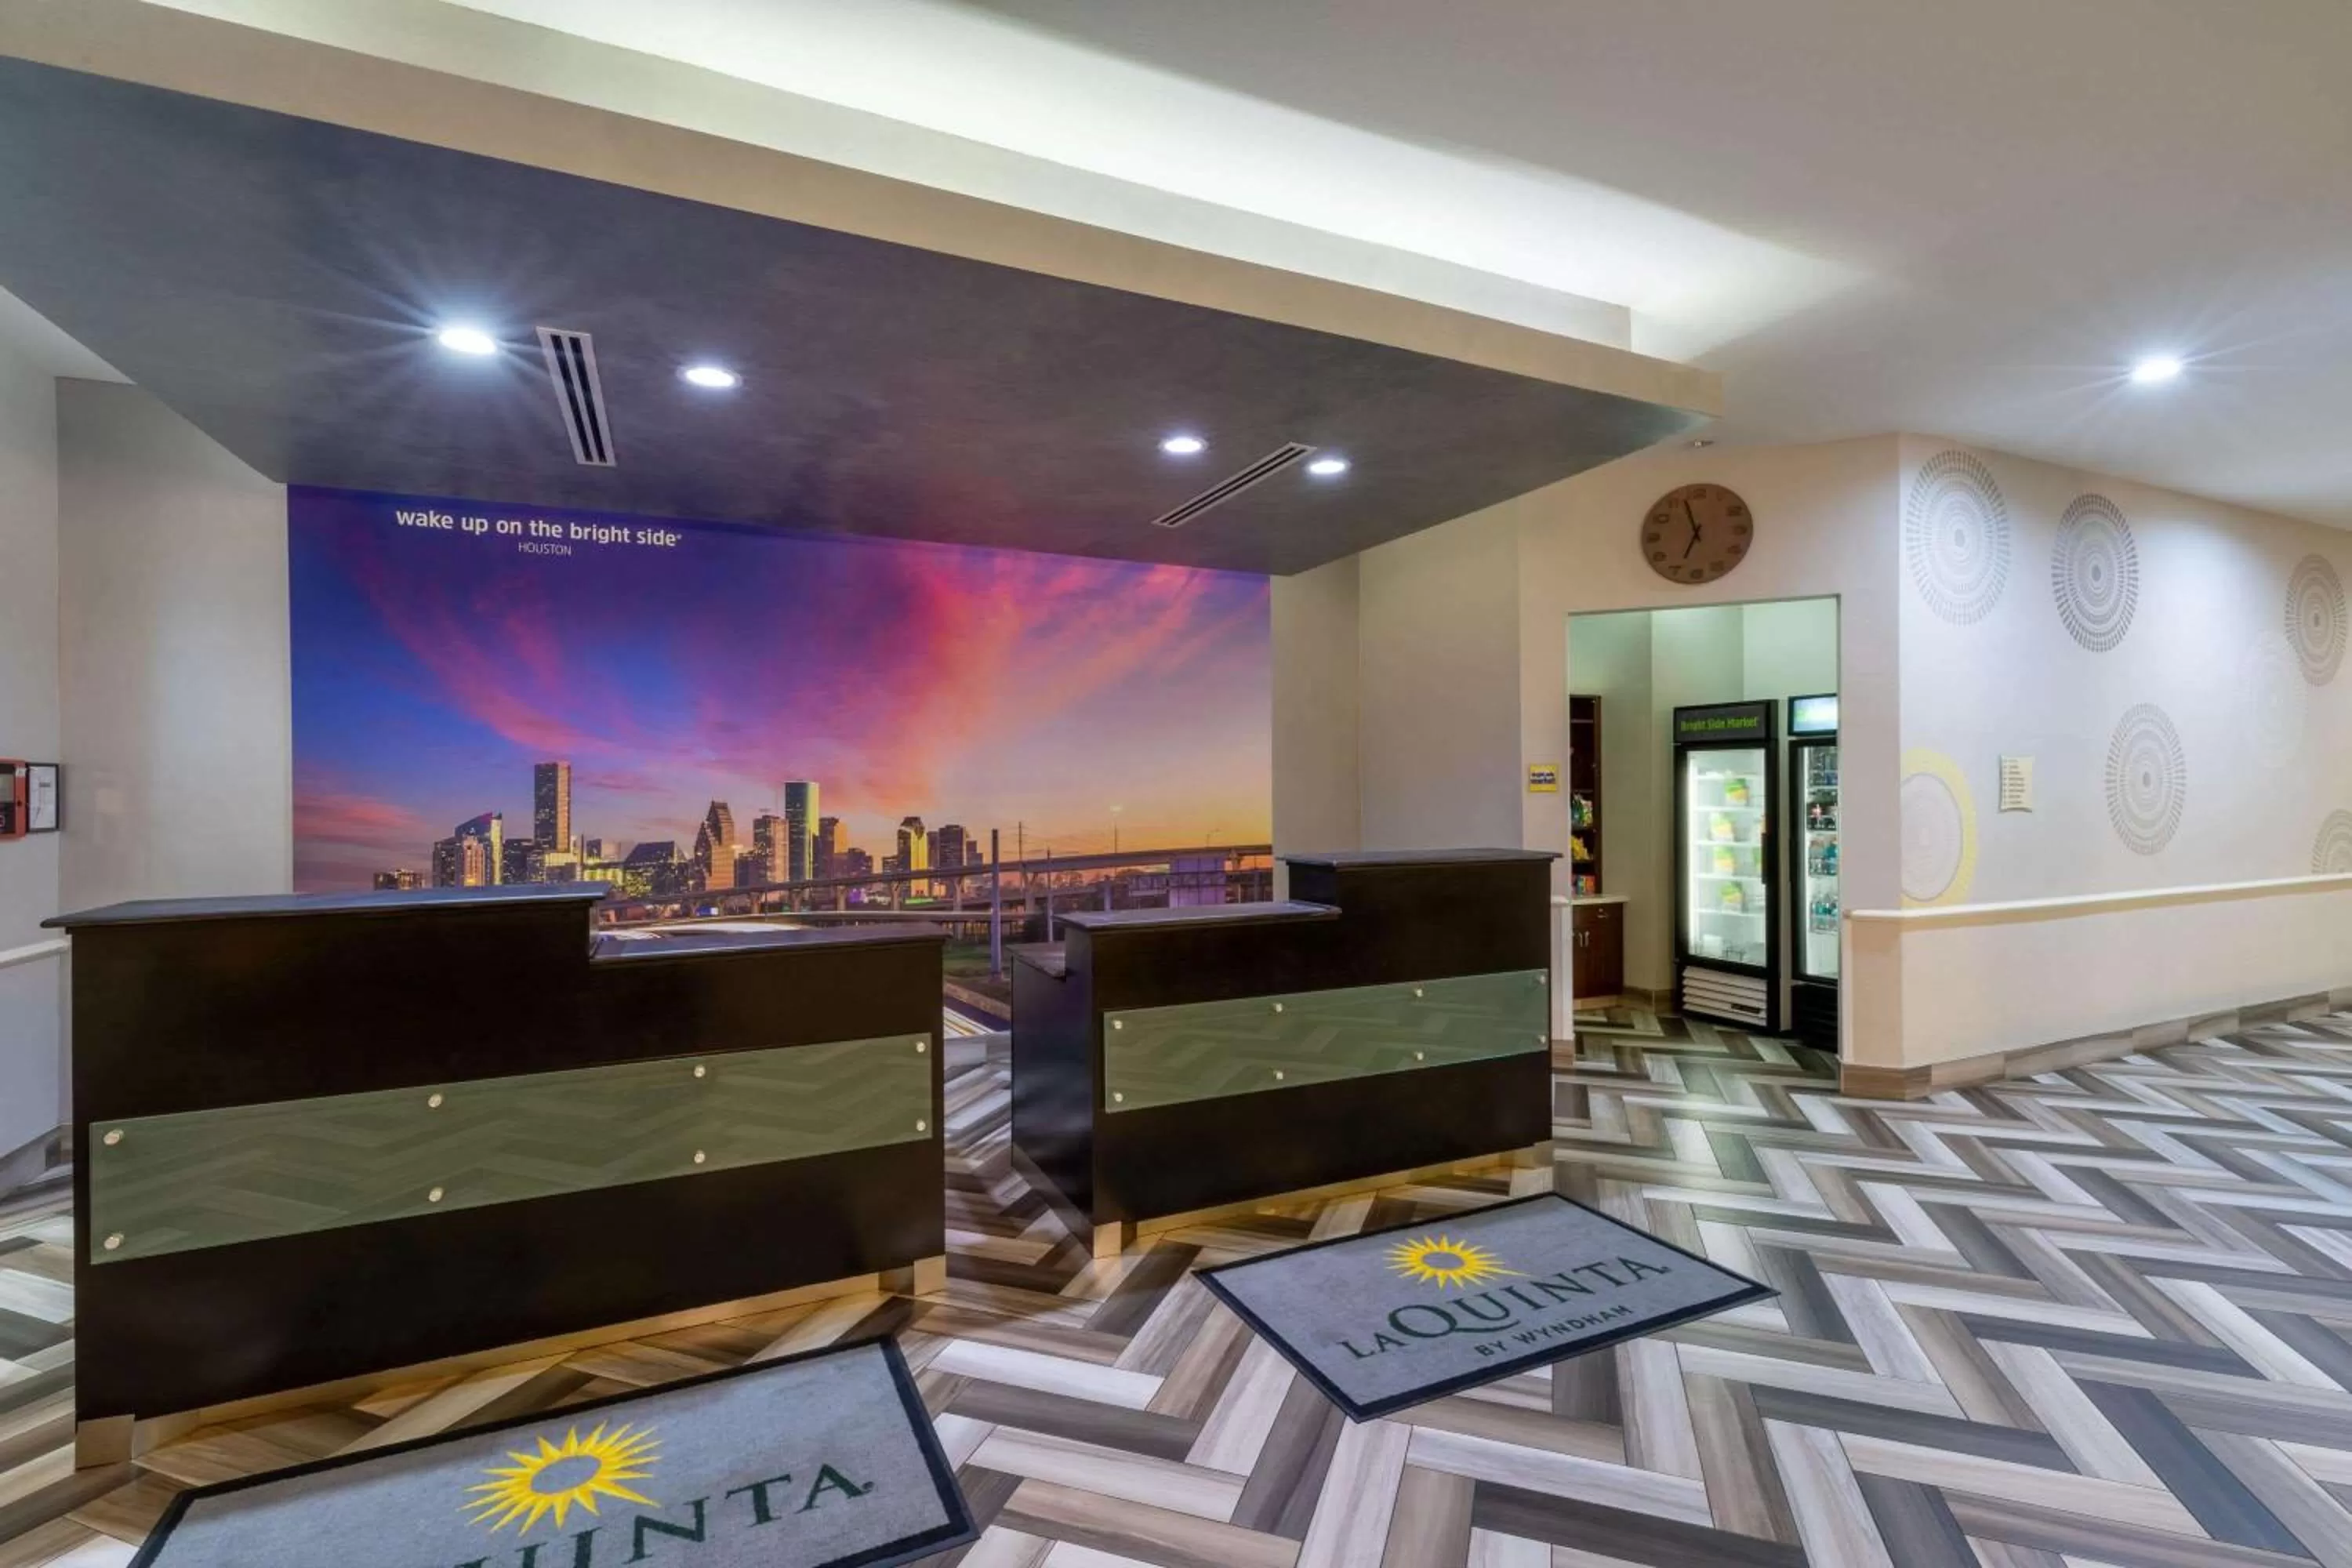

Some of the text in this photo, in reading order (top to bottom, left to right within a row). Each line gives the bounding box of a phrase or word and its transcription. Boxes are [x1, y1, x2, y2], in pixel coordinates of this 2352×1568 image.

[395, 510, 677, 547] wake up on the bright side
[517, 541, 572, 557] HOUSTON
[1726, 716, 1759, 729] Market
[1338, 1256, 1664, 1359] LA QUINTA
[1474, 1304, 1635, 1357] BY WYNDHAM
